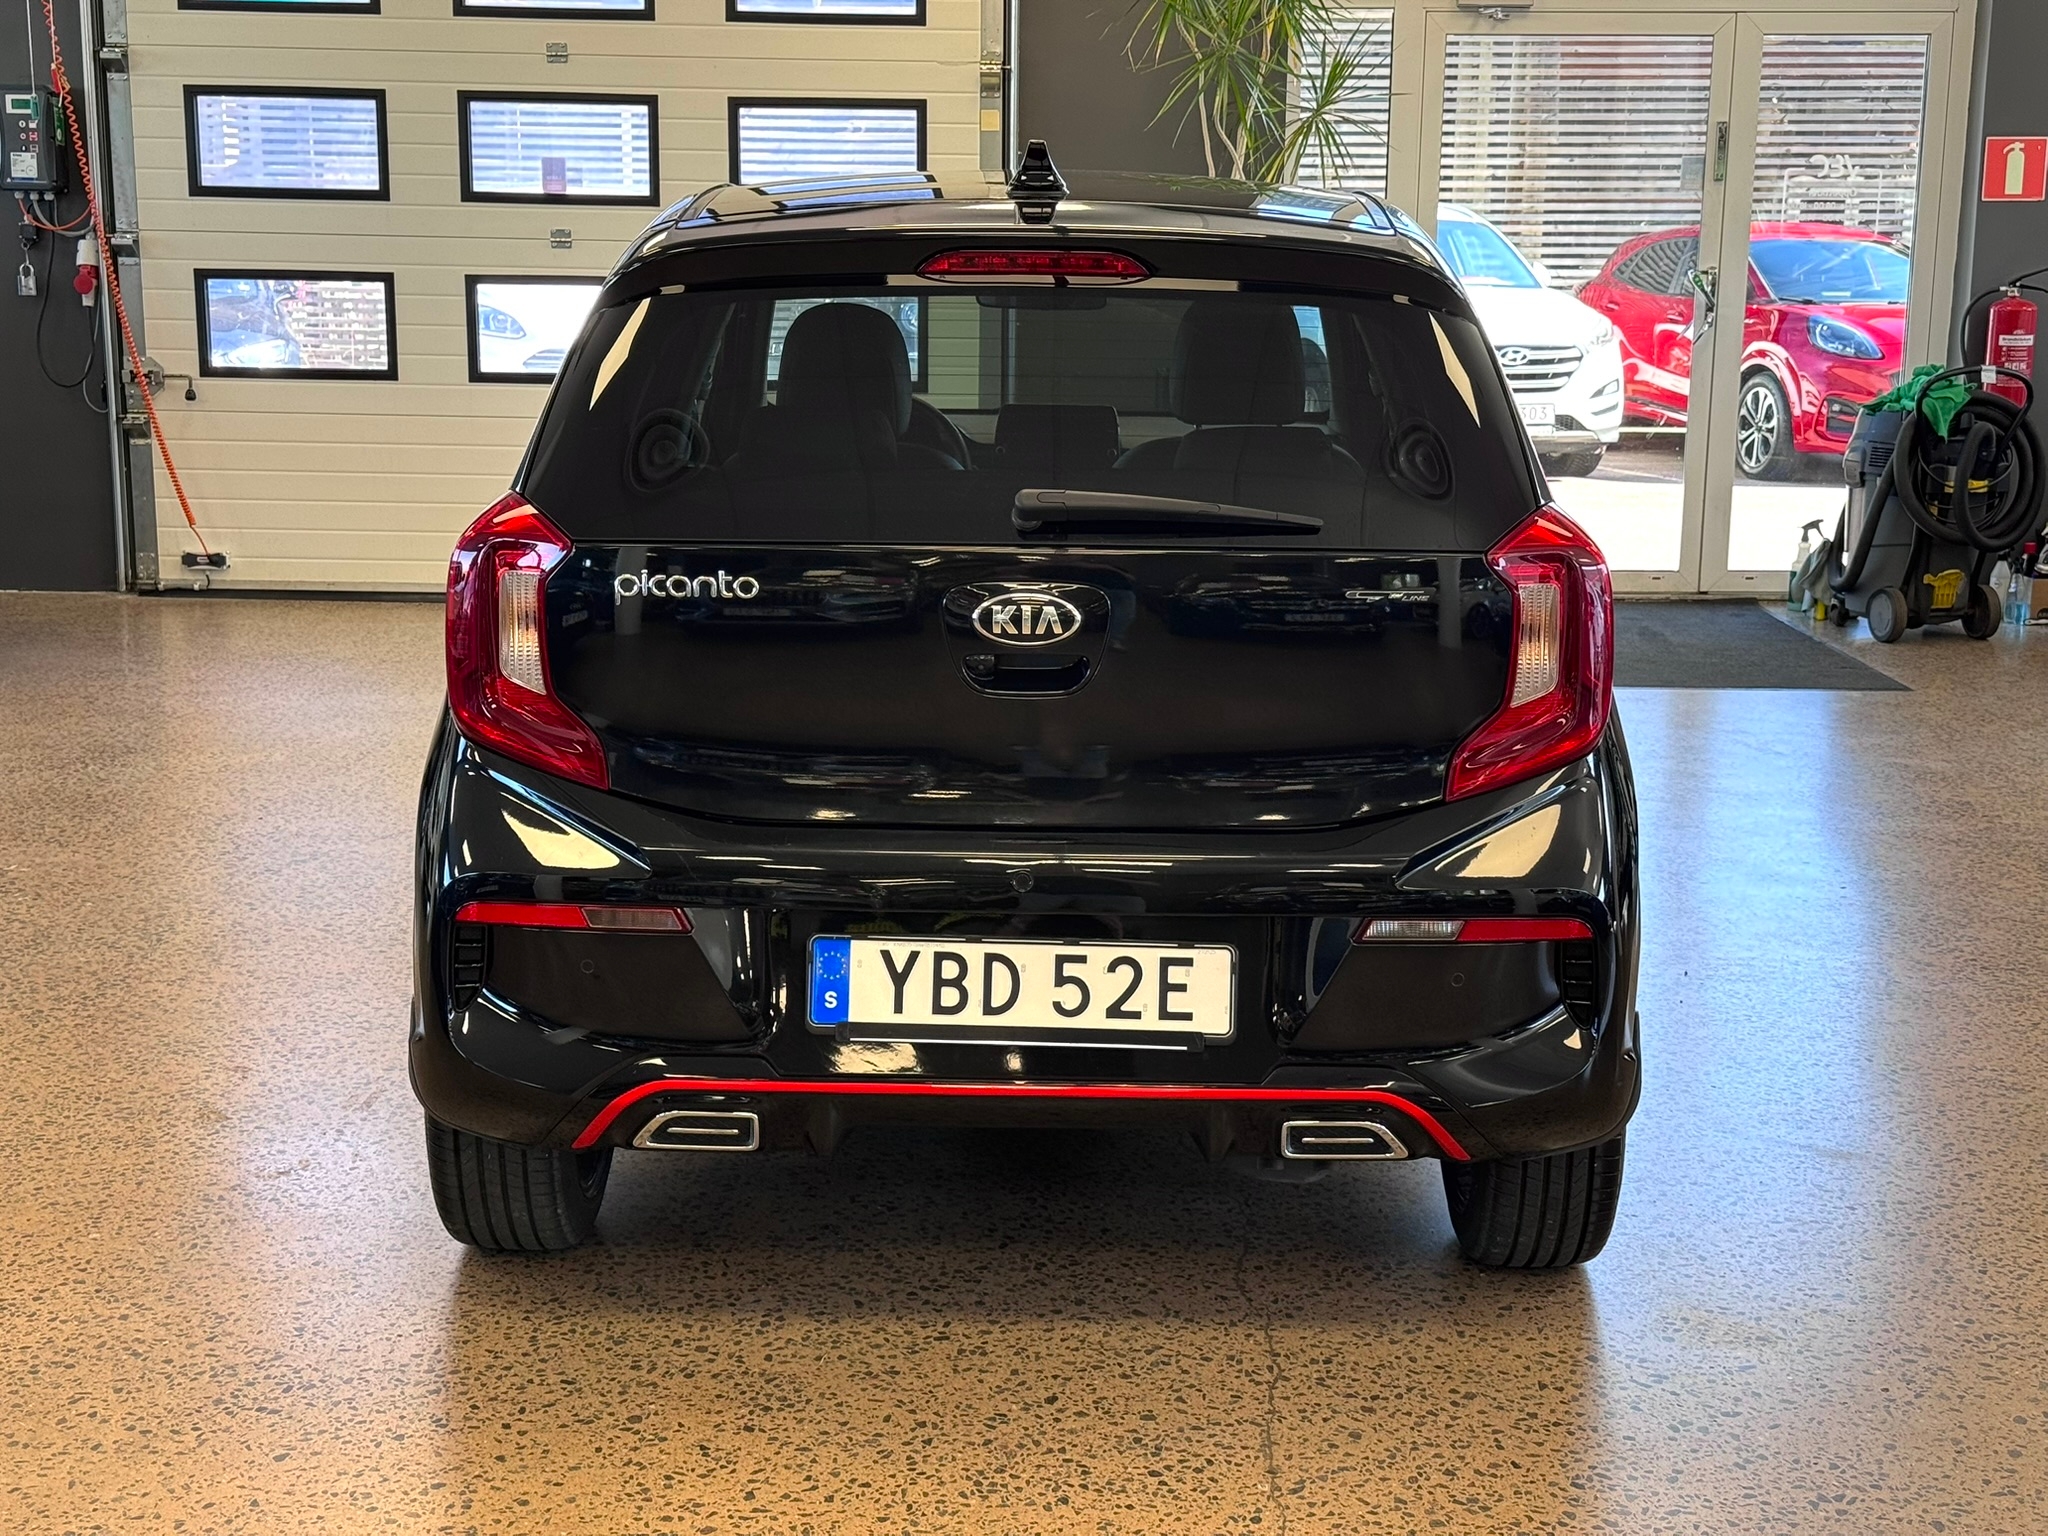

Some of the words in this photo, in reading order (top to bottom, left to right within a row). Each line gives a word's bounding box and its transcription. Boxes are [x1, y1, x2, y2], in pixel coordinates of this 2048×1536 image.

[614, 569, 760, 606] picanto
[990, 605, 1063, 634] KIA
[824, 991, 837, 1009] S
[880, 949, 1021, 1016] YBD
[1052, 954, 1194, 1021] 52E
